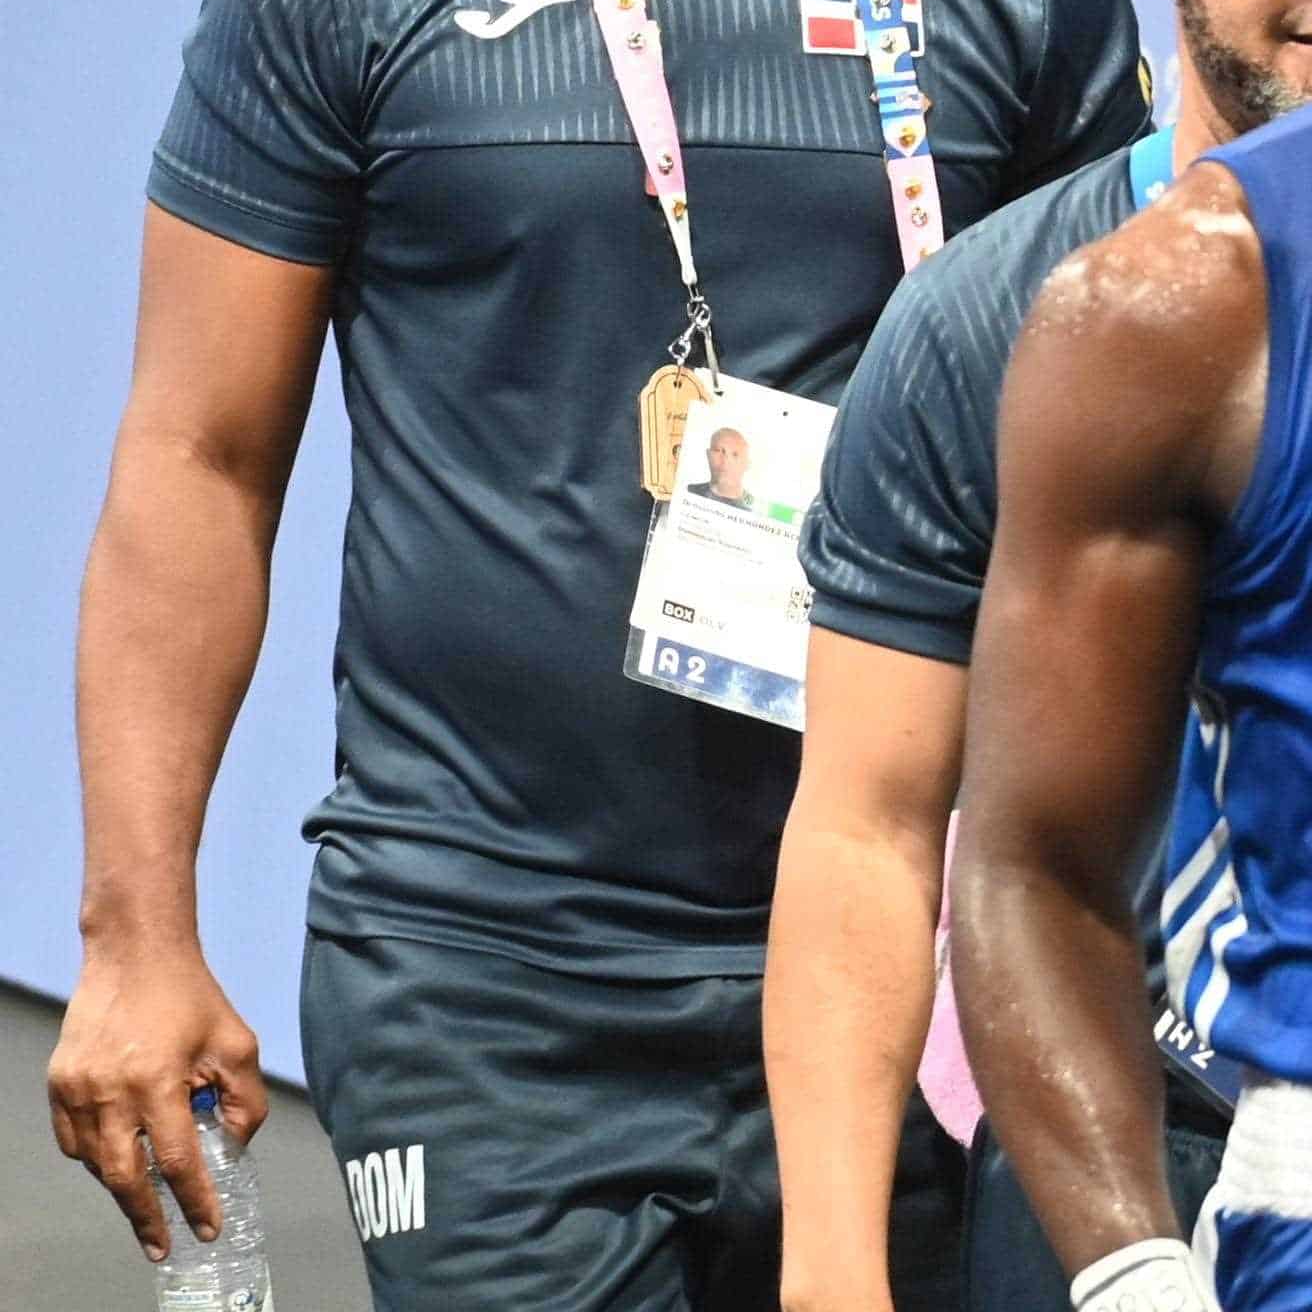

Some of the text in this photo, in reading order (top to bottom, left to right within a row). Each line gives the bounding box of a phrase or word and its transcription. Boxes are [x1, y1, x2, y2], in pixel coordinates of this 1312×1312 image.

[663, 601, 695, 623] BOX
[657, 647, 707, 684] A 2
[346, 1143, 425, 1242] DOM
